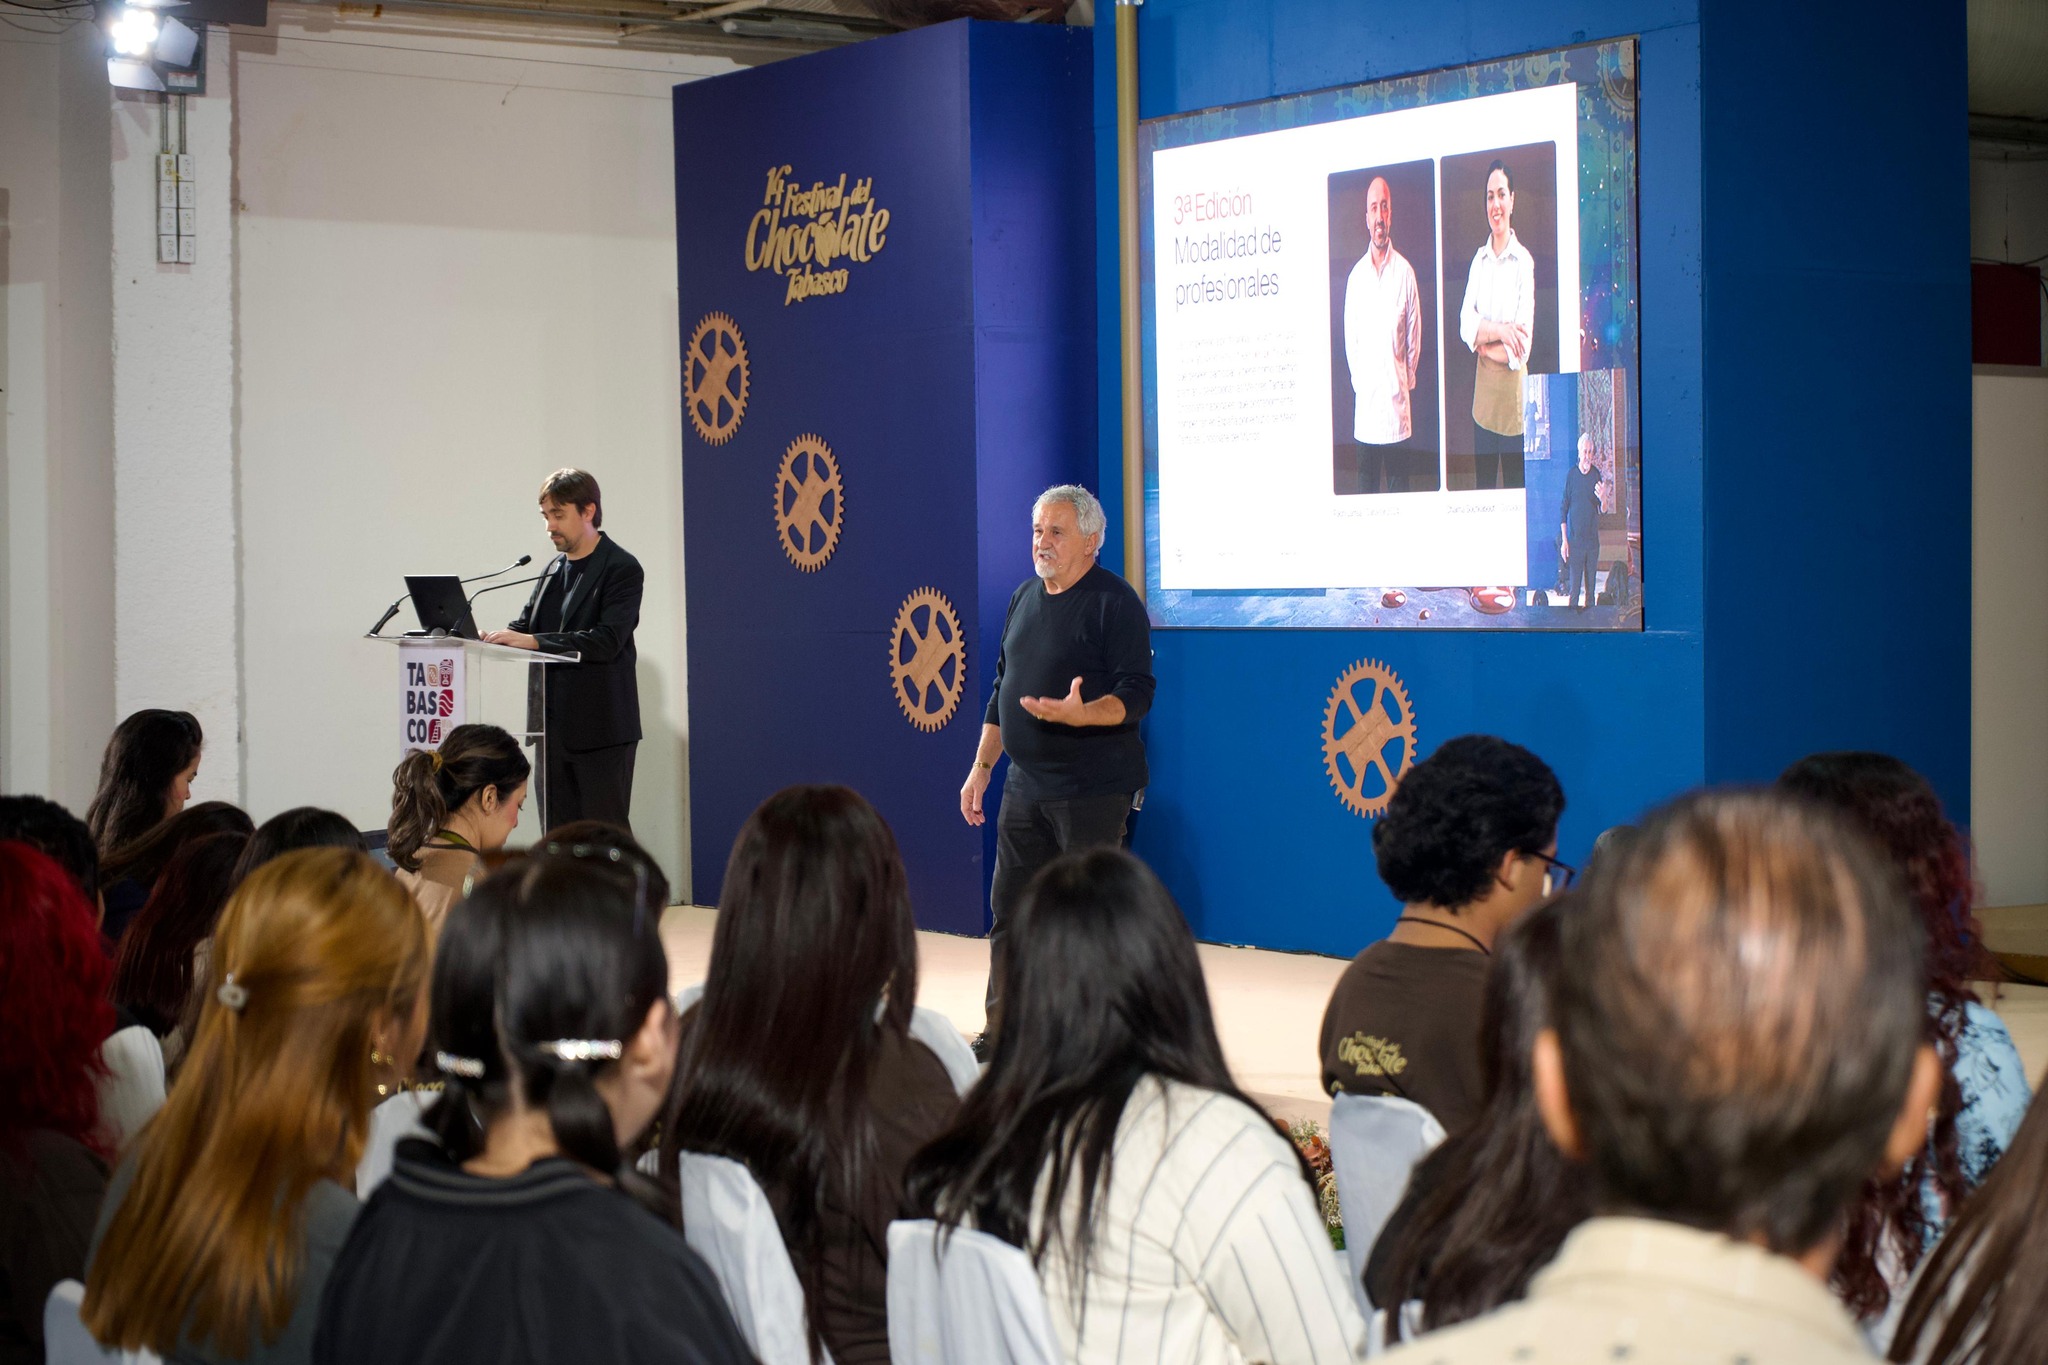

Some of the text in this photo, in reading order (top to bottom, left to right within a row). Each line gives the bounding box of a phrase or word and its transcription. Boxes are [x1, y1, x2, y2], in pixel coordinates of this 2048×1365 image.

[782, 173, 846, 218] Festival
[850, 177, 872, 205] del
[1196, 186, 1252, 222] Edición
[745, 197, 890, 275] Chocolate
[1175, 224, 1282, 265] Modalidad de
[785, 263, 849, 306] Tabasco
[1176, 268, 1279, 312] profesionales
